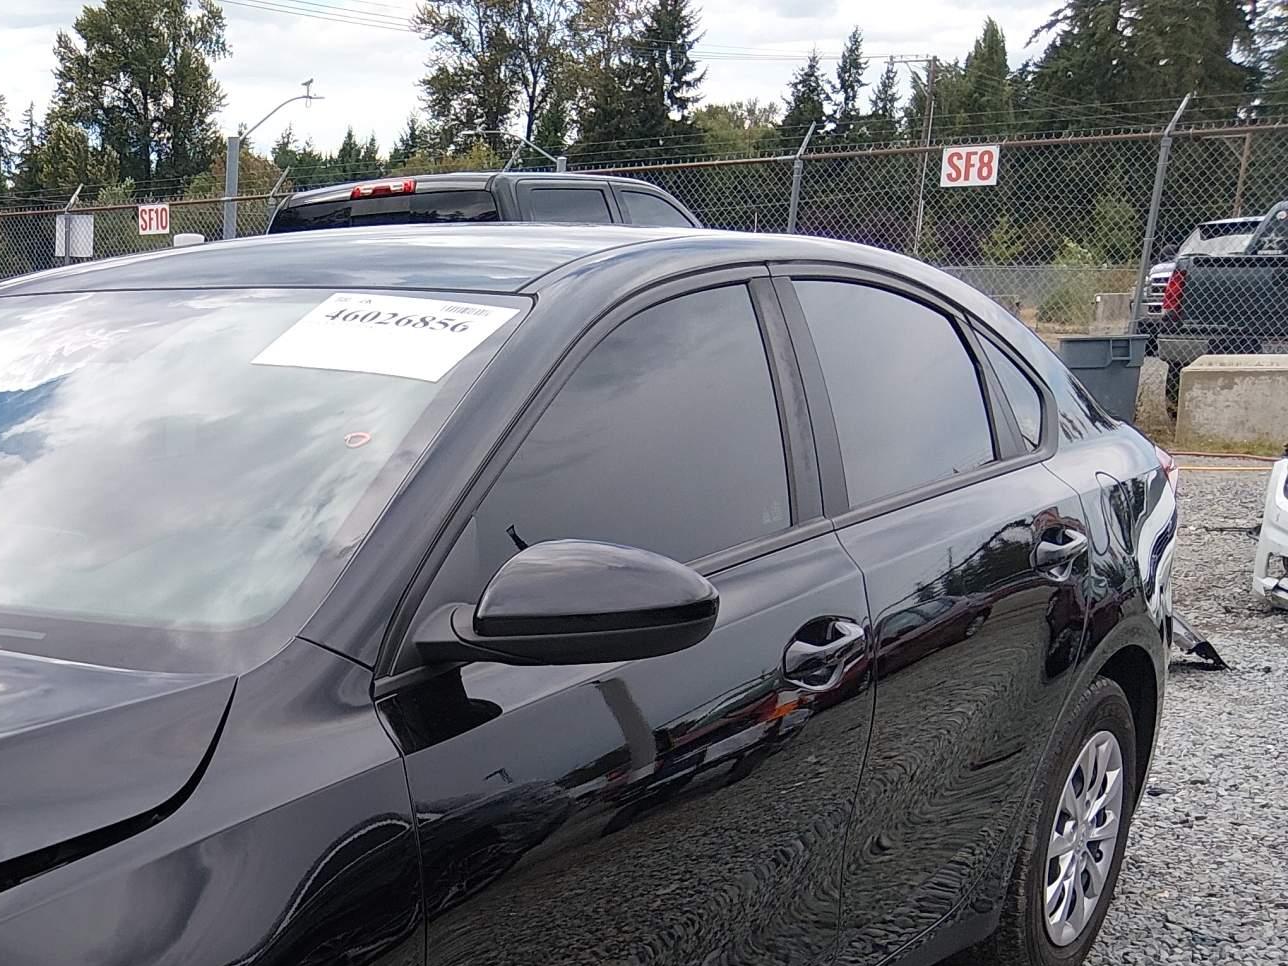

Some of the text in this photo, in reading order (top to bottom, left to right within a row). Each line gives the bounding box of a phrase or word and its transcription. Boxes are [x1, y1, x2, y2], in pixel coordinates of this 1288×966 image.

[946, 150, 994, 182] SF8
[139, 207, 168, 231] SF10
[325, 308, 470, 334] 46026856
